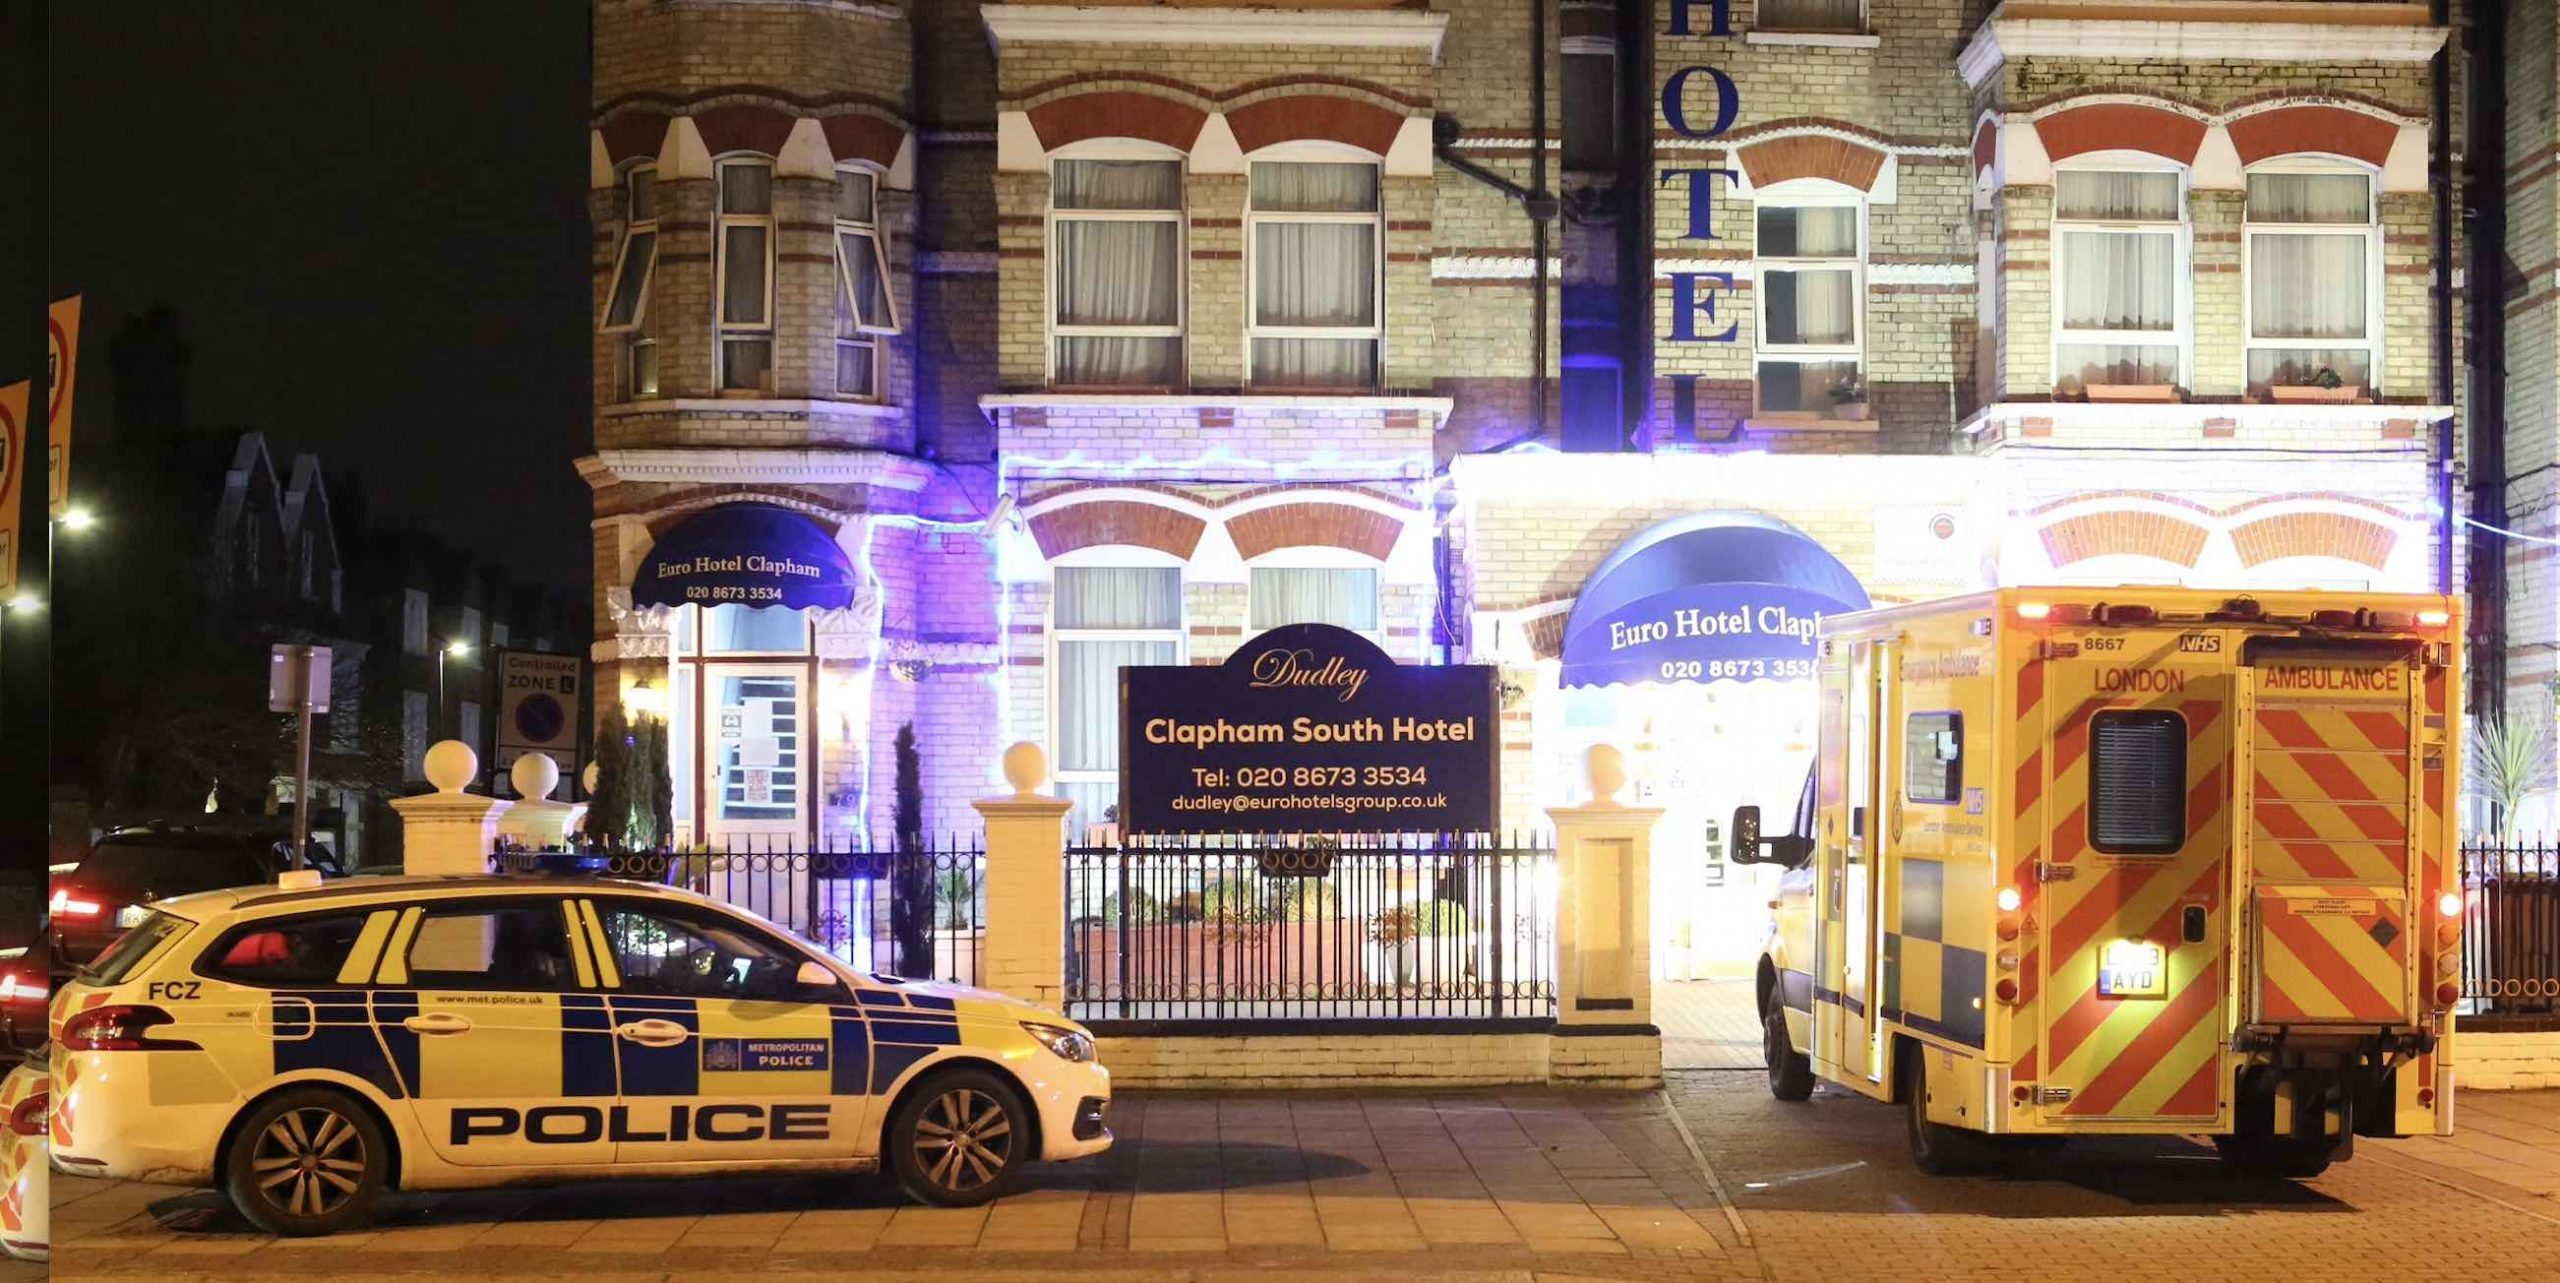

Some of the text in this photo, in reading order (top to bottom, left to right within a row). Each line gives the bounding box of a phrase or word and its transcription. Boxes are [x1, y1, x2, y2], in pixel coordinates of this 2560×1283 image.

[657, 555, 821, 578] Euro Hotel Clapham
[687, 587, 782, 599] 020 8673 3534
[1610, 621, 1668, 651] Euro
[1674, 605, 1752, 637] Hotel
[2084, 636, 2219, 652] 8667 NHS
[1250, 648, 1370, 703] Dudley
[1661, 661, 1702, 678] 020
[1709, 660, 1765, 677] 8673
[2264, 665, 2400, 691] AMBULANCE
[507, 675, 557, 690] ZONE
[2094, 668, 2184, 693] LONDON
[1145, 716, 1475, 749] Clapham South Hotel
[1192, 767, 1427, 788] Tel: 020 8673 3534
[1172, 793, 1447, 815] dudley@eurohotelsgroup.co.uk
[2113, 970, 2152, 988] AYD
[149, 982, 201, 1000] FCZ
[436, 995, 543, 1005] www.met.police.uk
[748, 1044, 824, 1053] METROPOLITAN
[759, 1056, 814, 1066] POLICE
[450, 1104, 831, 1146] POLICE
